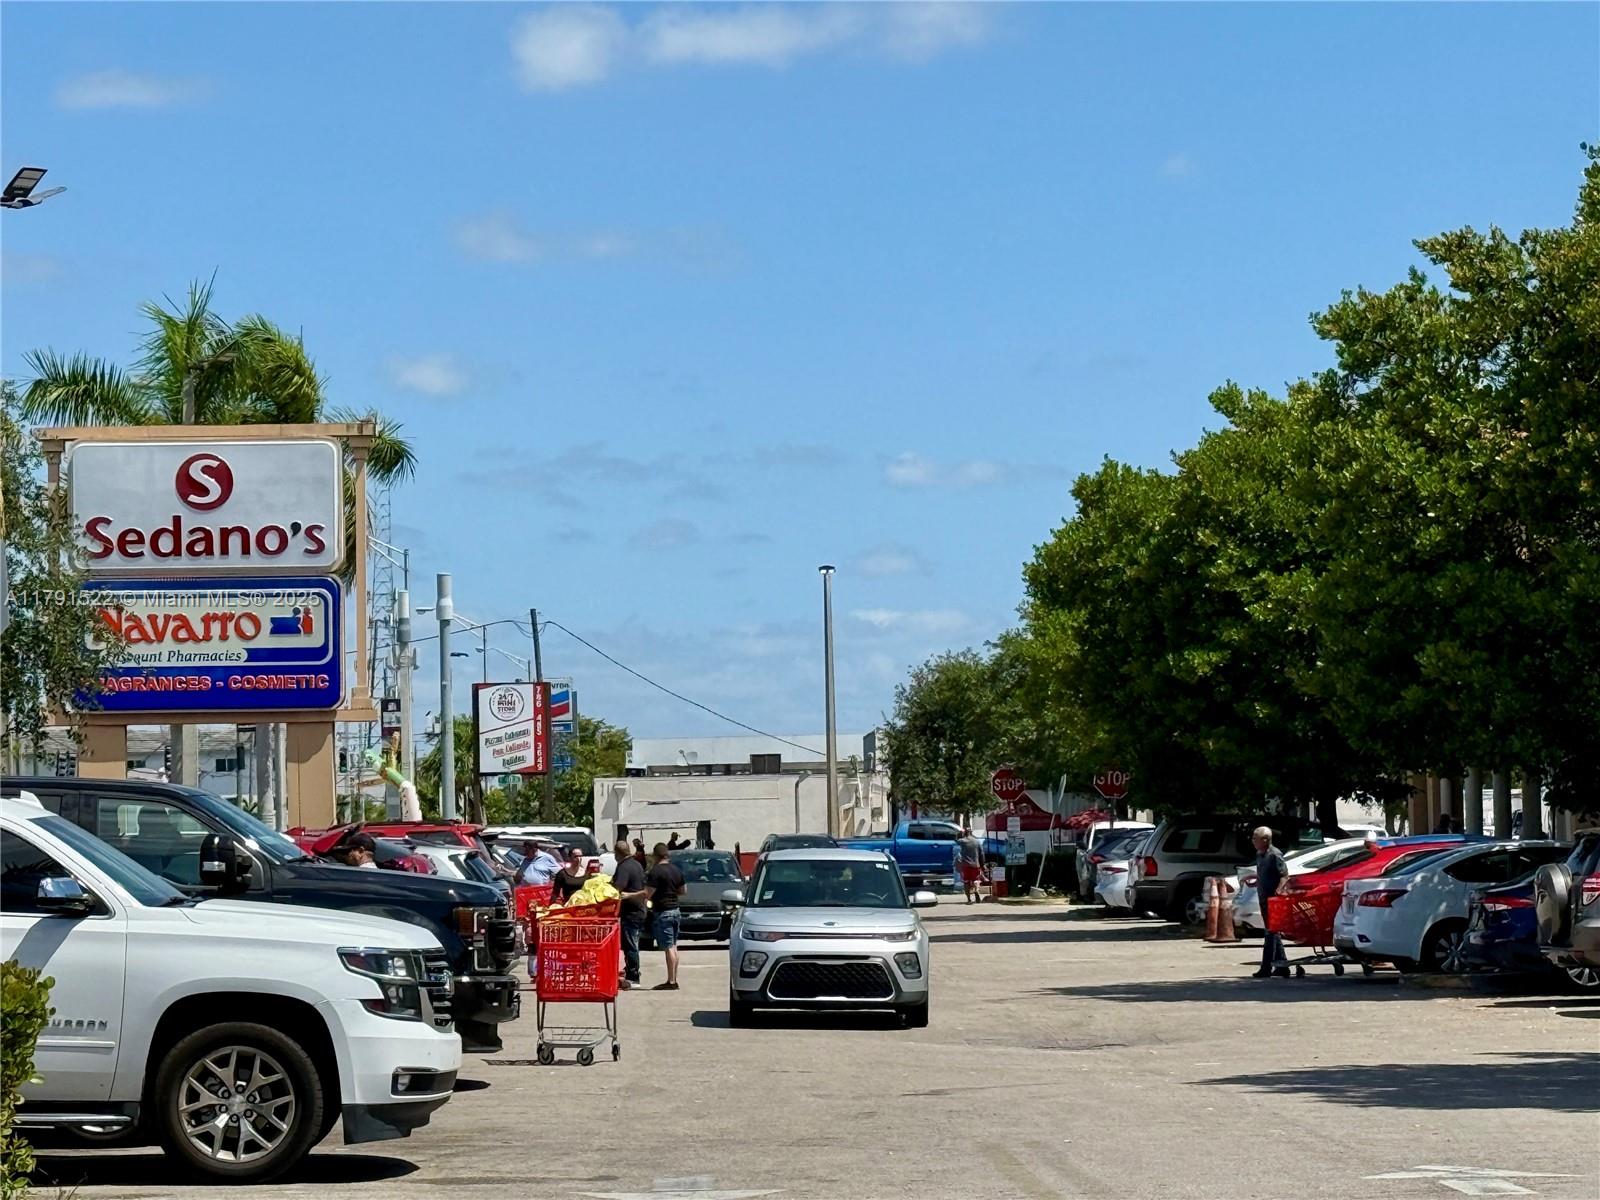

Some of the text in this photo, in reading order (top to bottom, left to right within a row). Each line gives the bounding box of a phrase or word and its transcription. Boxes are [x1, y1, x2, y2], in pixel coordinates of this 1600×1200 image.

[83, 515, 326, 559] Sedano's
[95, 607, 261, 643] Navarro
[167, 649, 243, 663] Pharmacies
[97, 675, 211, 692] AGRANCES
[229, 674, 330, 690] COSMETIC
[993, 777, 1023, 792] STOP
[47, 1018, 108, 1028] URBAN
